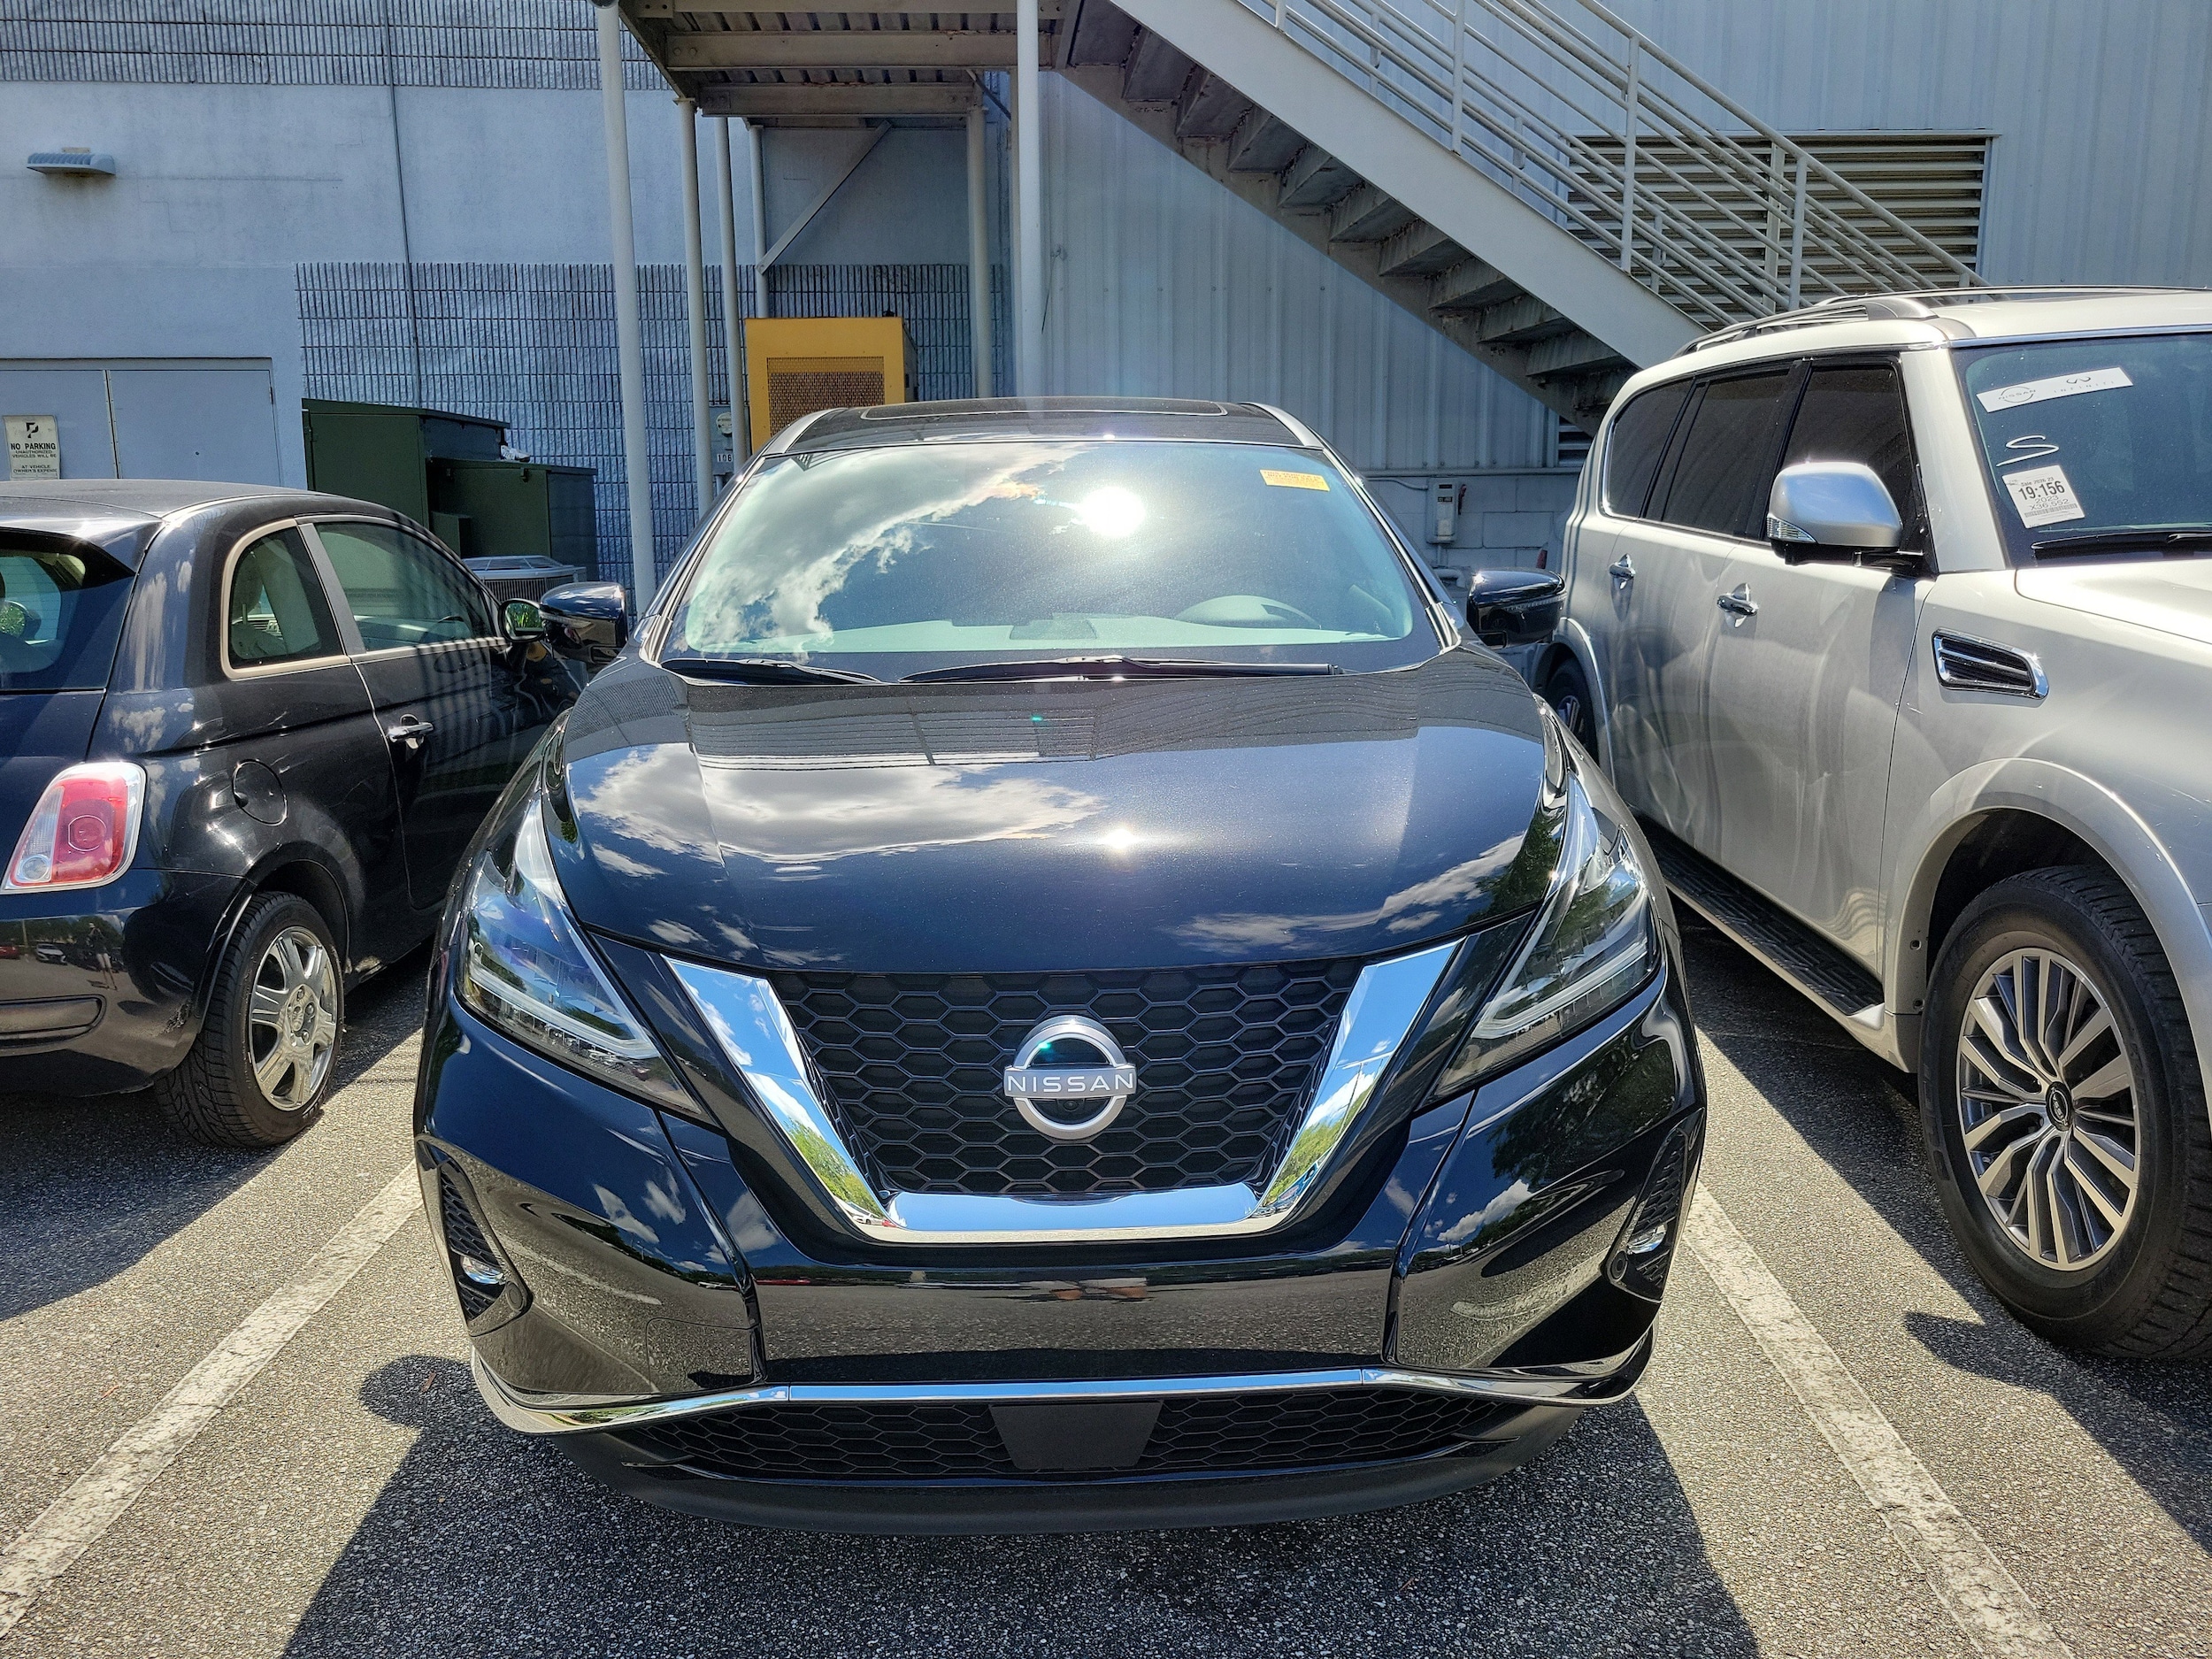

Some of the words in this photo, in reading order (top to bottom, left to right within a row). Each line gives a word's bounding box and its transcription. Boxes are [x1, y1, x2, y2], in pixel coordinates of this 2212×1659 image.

[1998, 388, 2037, 400] NISSAN
[2018, 480, 2066, 500] 19:156
[2035, 495, 2059, 504] 2023
[1007, 1072, 1134, 1093] NISSAN
